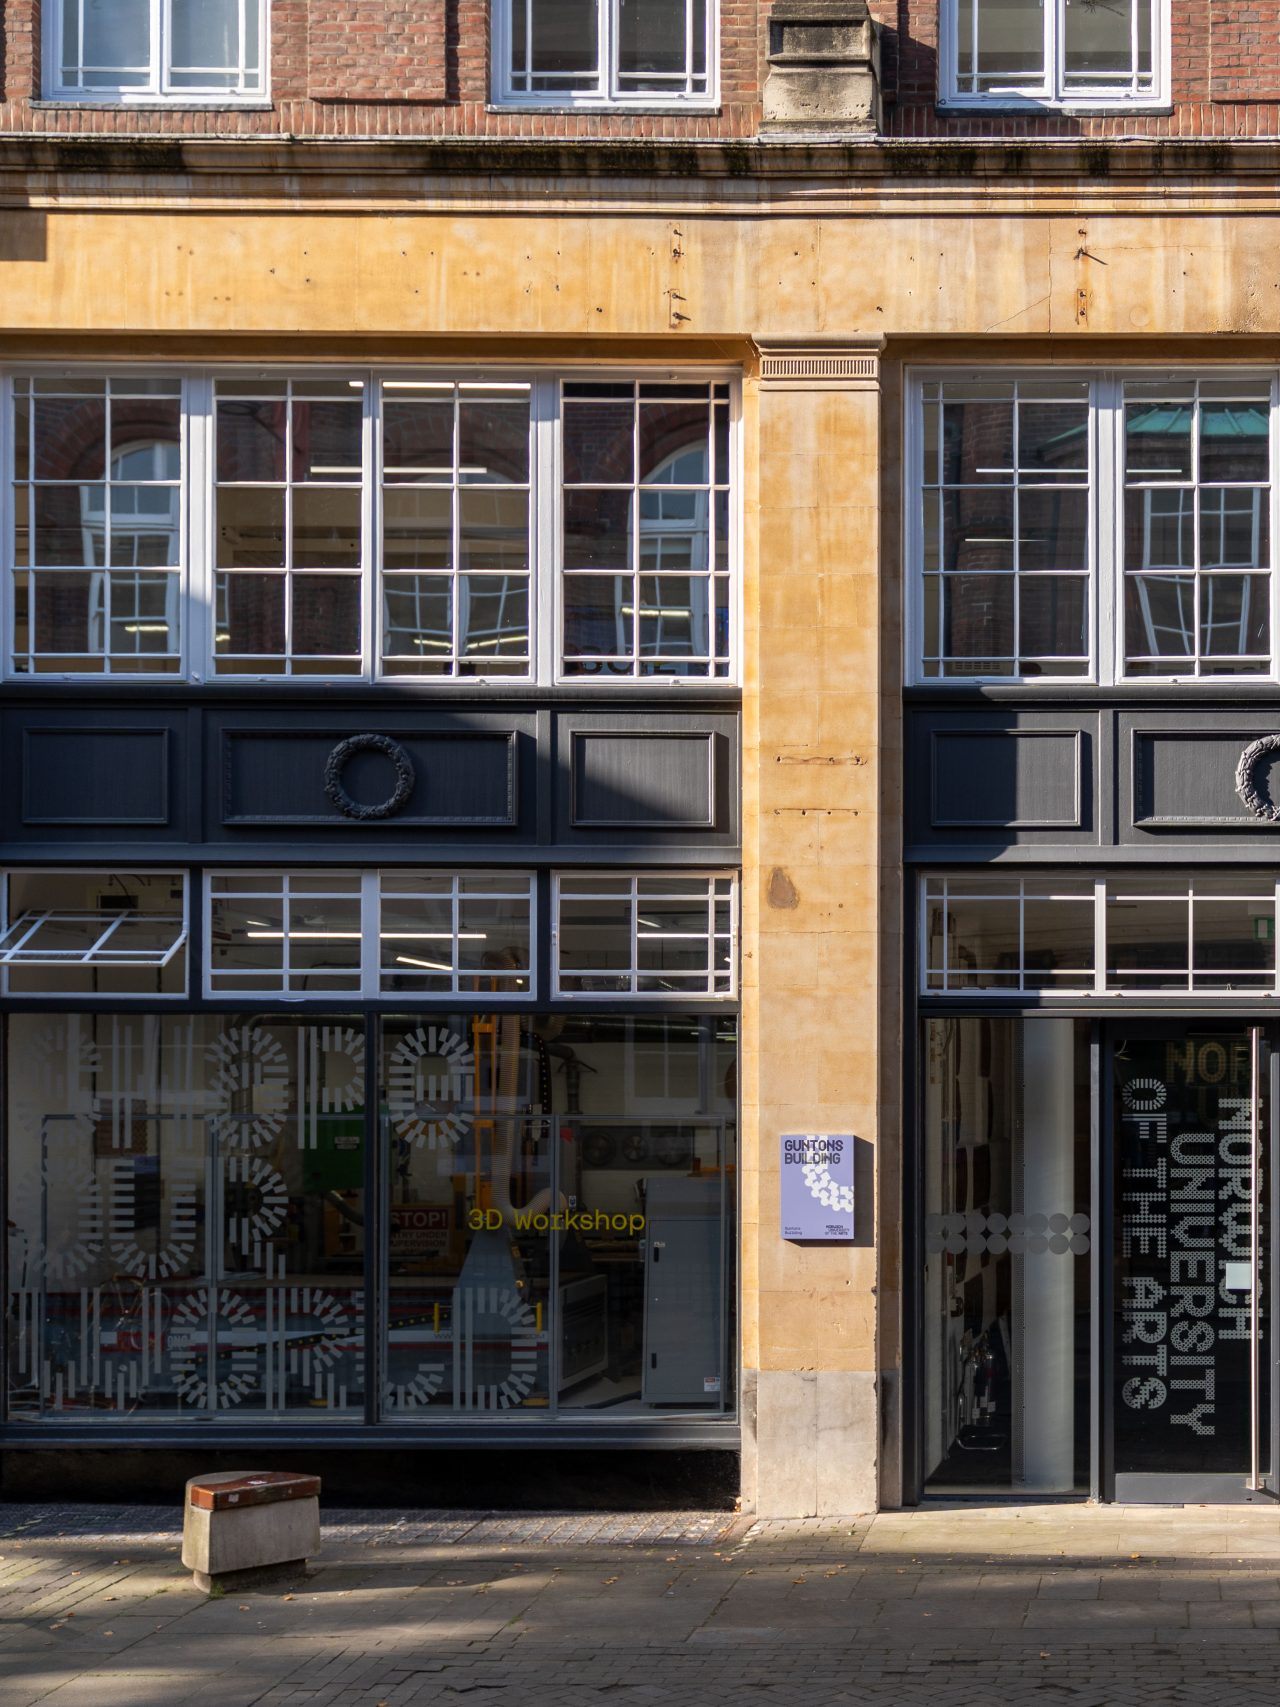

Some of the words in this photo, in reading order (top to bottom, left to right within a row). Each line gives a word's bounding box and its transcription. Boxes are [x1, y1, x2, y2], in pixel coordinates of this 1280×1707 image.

[1122, 1078, 1167, 1144] OF
[784, 1139, 844, 1152] GUNTONS
[784, 1152, 841, 1165] BUILDING
[390, 1211, 447, 1227] STOP!
[467, 1209, 503, 1231] 3D
[514, 1208, 646, 1236] Workshop
[1122, 1157, 1167, 1259] THE
[390, 1231, 413, 1239] NTRY
[1170, 1132, 1215, 1436] UNIVERSITY
[1122, 1276, 1167, 1410] ARTS
